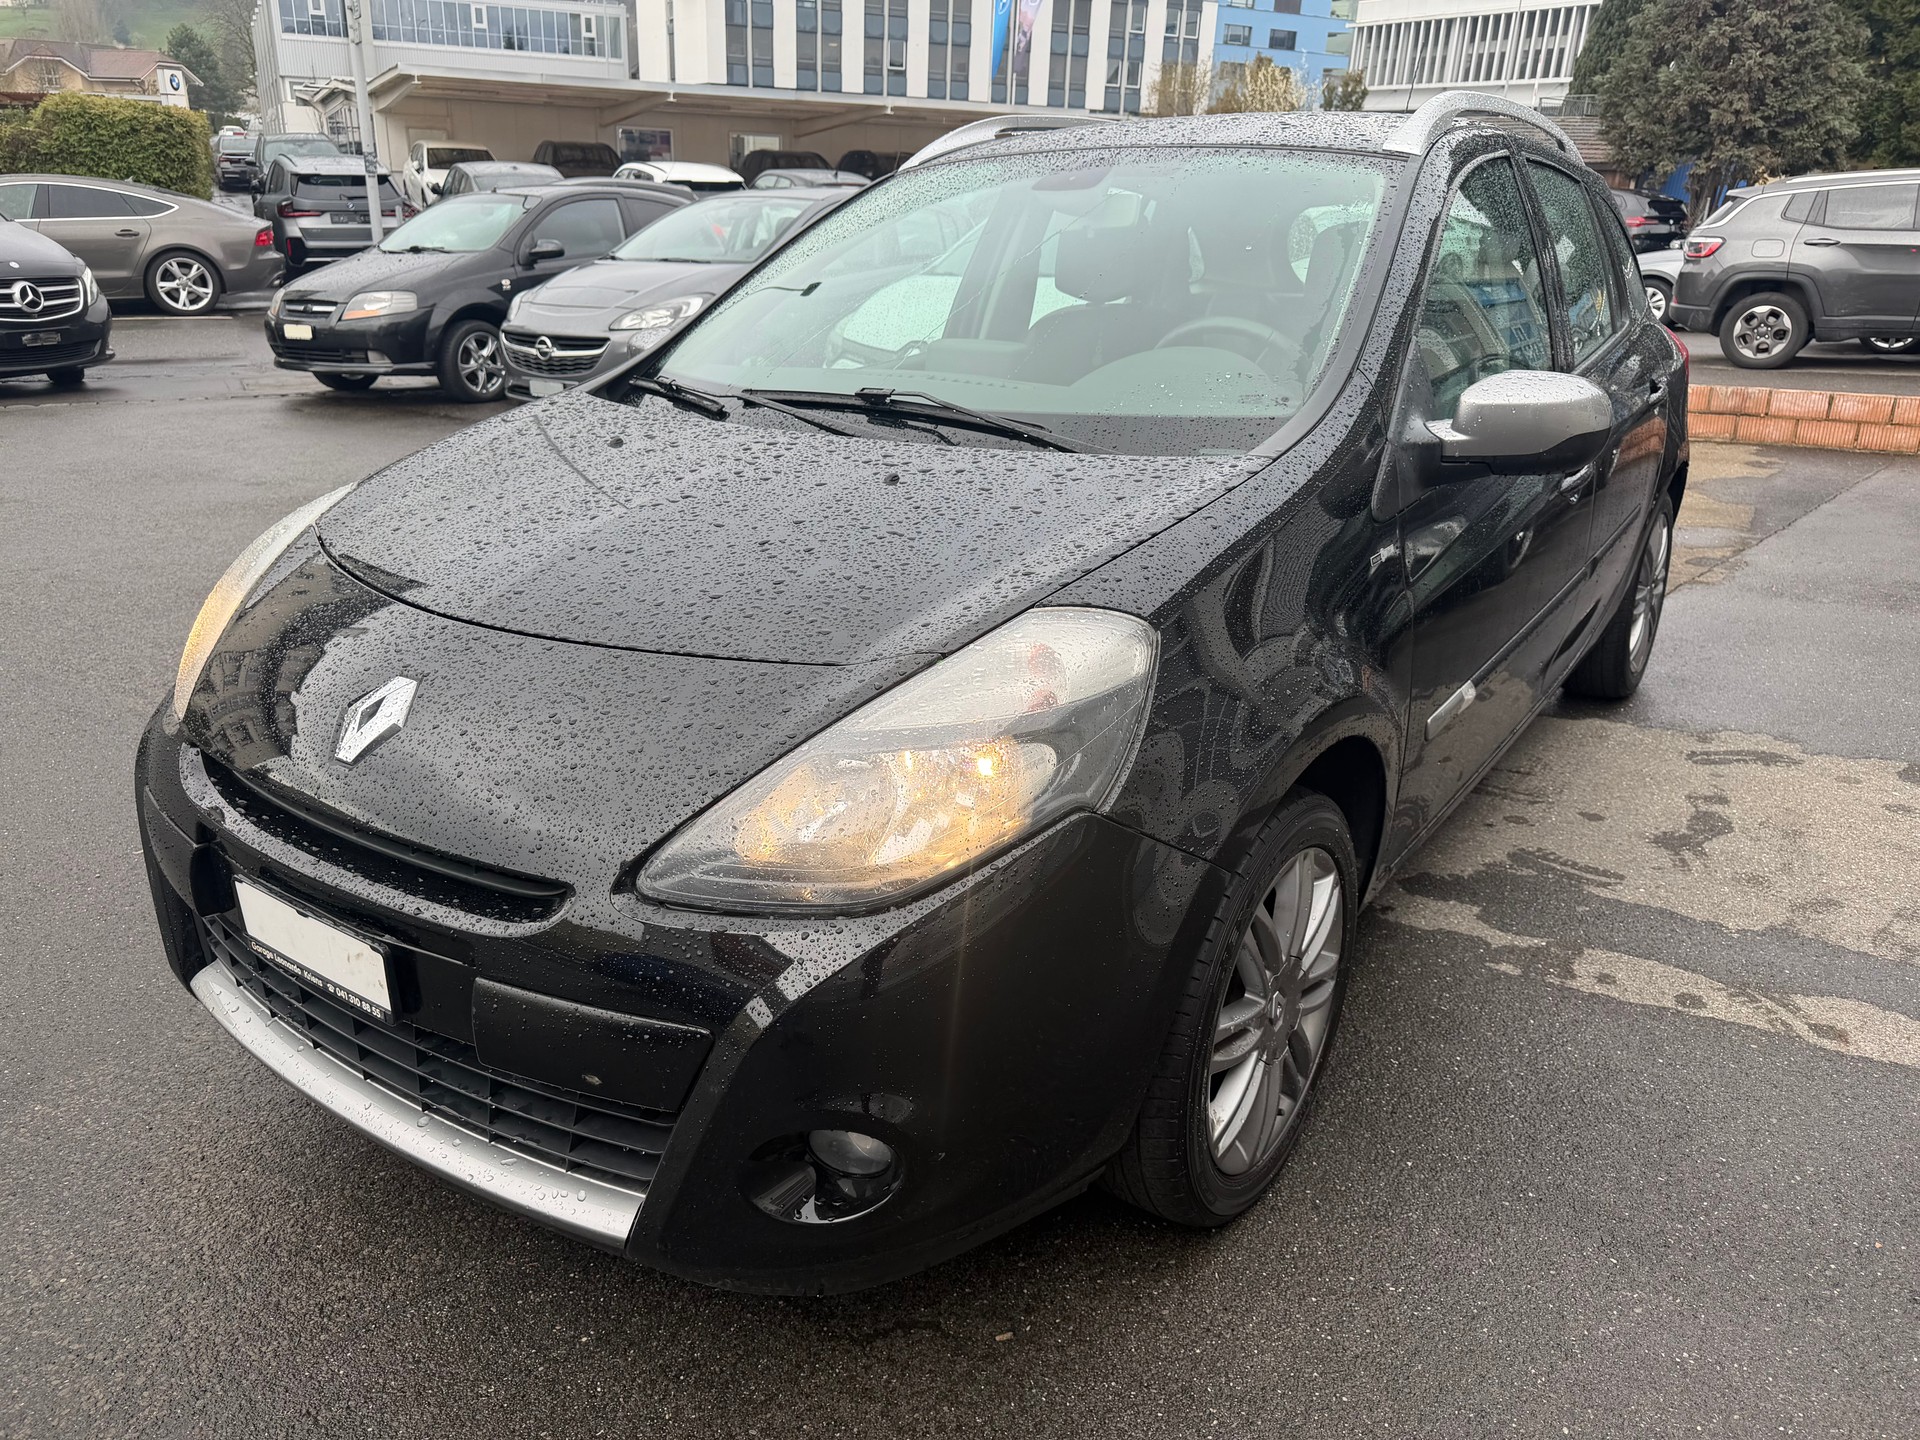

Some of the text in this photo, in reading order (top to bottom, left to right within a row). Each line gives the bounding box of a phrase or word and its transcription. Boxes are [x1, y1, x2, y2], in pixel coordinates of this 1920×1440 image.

[251, 941, 274, 959] Garage
[336, 987, 348, 1001] 041
[349, 995, 361, 1007] 310
[372, 1006, 381, 1018] 55
